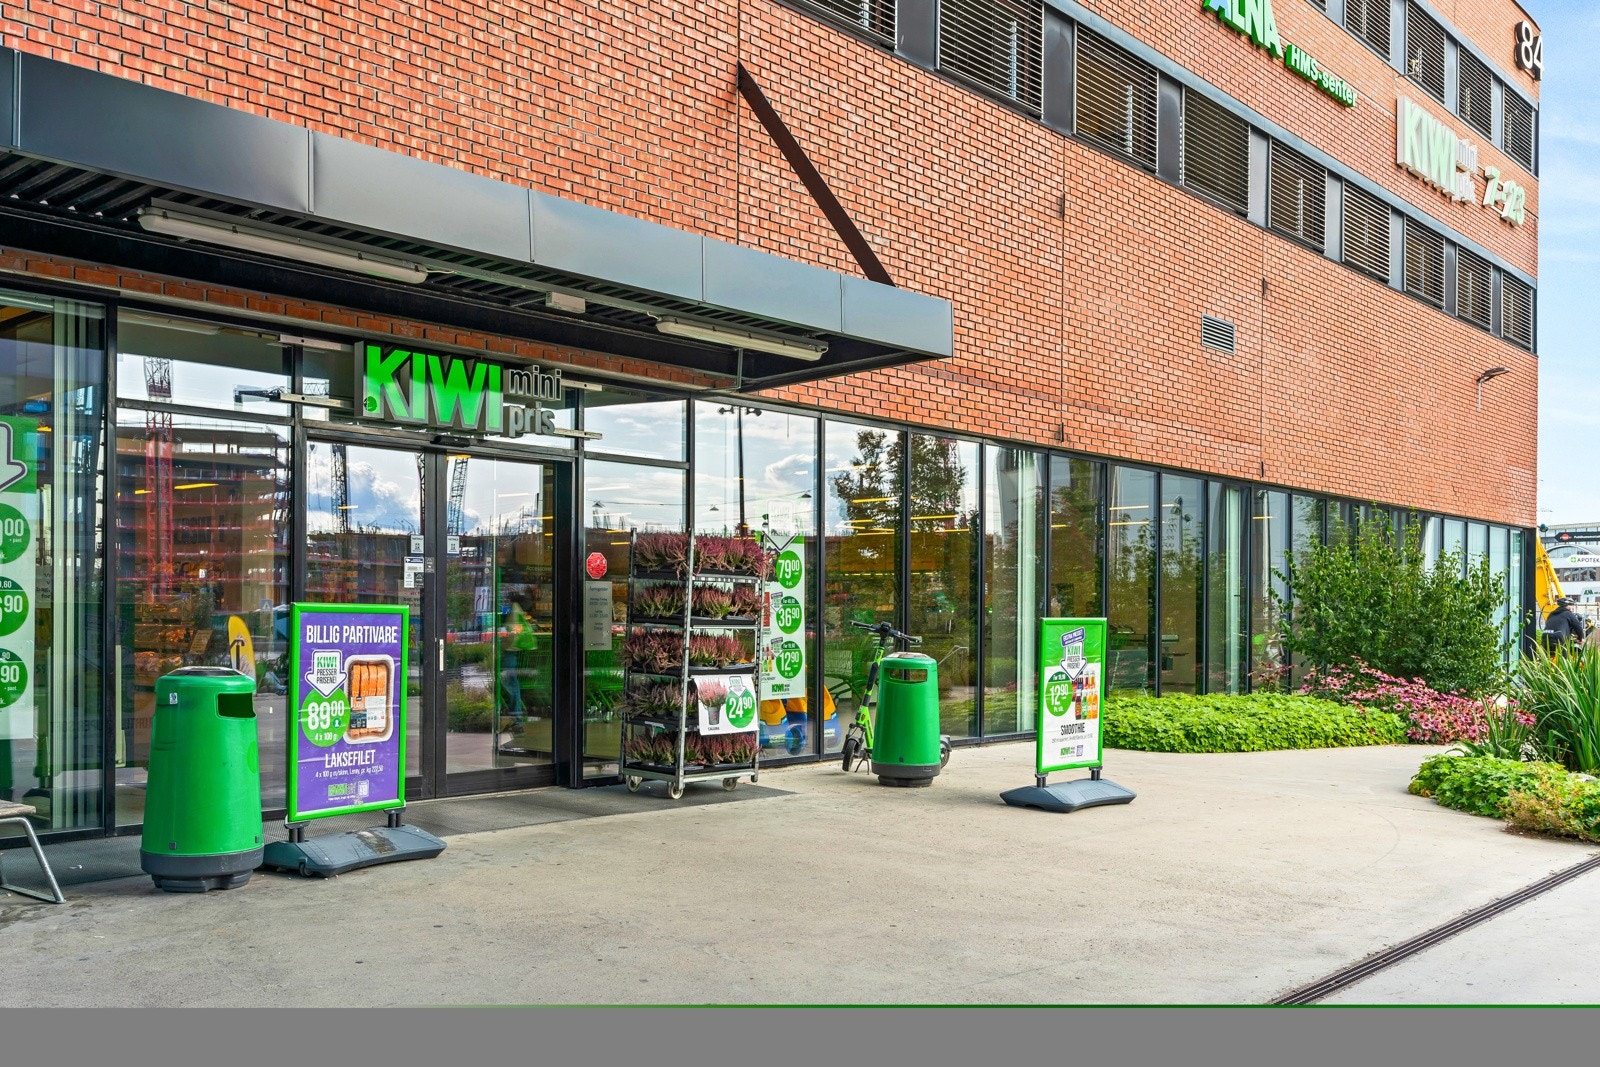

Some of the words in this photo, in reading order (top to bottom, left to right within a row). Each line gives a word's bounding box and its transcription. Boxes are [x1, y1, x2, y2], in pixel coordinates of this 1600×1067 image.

[1203, 0, 1284, 60] LNA
[1515, 20, 1543, 81] 84
[1287, 44, 1357, 107] HMS-senter
[1398, 96, 1456, 197] KIWI
[361, 343, 504, 433] KIWI
[508, 365, 562, 400] mini
[509, 401, 557, 438] pris
[306, 625, 340, 644] BILLIG
[342, 625, 398, 644] PARTIVARE
[316, 656, 337, 668] KIWI
[316, 668, 338, 676] PRESSER
[325, 749, 376, 769] LAKSEFILET
